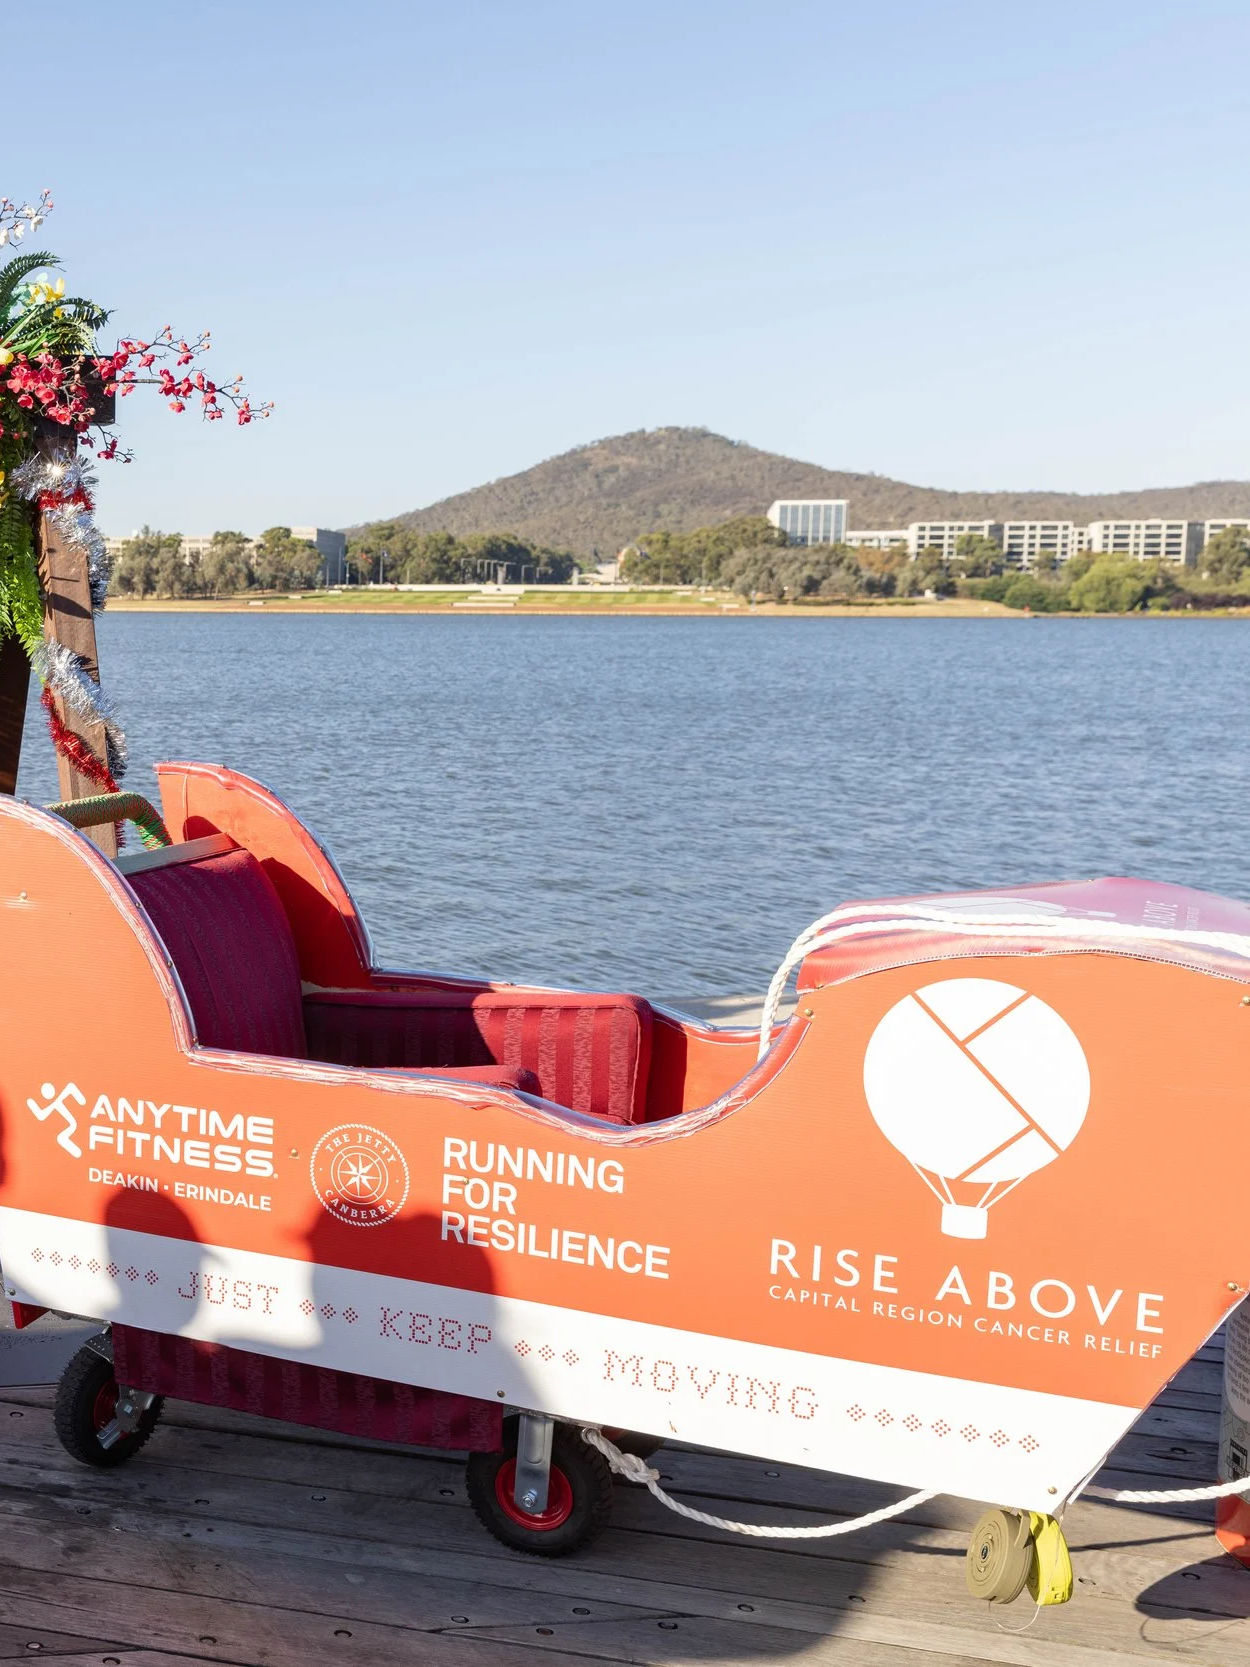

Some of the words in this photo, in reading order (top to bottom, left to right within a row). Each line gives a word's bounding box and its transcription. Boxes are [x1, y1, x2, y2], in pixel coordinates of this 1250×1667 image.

[90, 1094, 274, 1145] ANYTIME
[325, 1133, 351, 1153] THE
[356, 1132, 397, 1163] JETTY
[443, 1136, 625, 1194] RUNNING
[88, 1167, 159, 1193] DEAKIN
[174, 1181, 272, 1212] ERINDALE
[325, 1189, 396, 1219] CANBERRA
[442, 1173, 518, 1215] FOR
[441, 1210, 671, 1280] RESILIENCE
[770, 1238, 898, 1294] RISE
[934, 1265, 1164, 1334] ABOVE
[178, 1271, 279, 1315] JUST
[380, 1306, 492, 1354] KEEP
[603, 1349, 819, 1420] MOVING
[769, 1285, 861, 1313] CAPITAL
[873, 1301, 963, 1329] REGION
[974, 1317, 1071, 1346] CANCER
[1084, 1334, 1163, 1359] RELIEF
